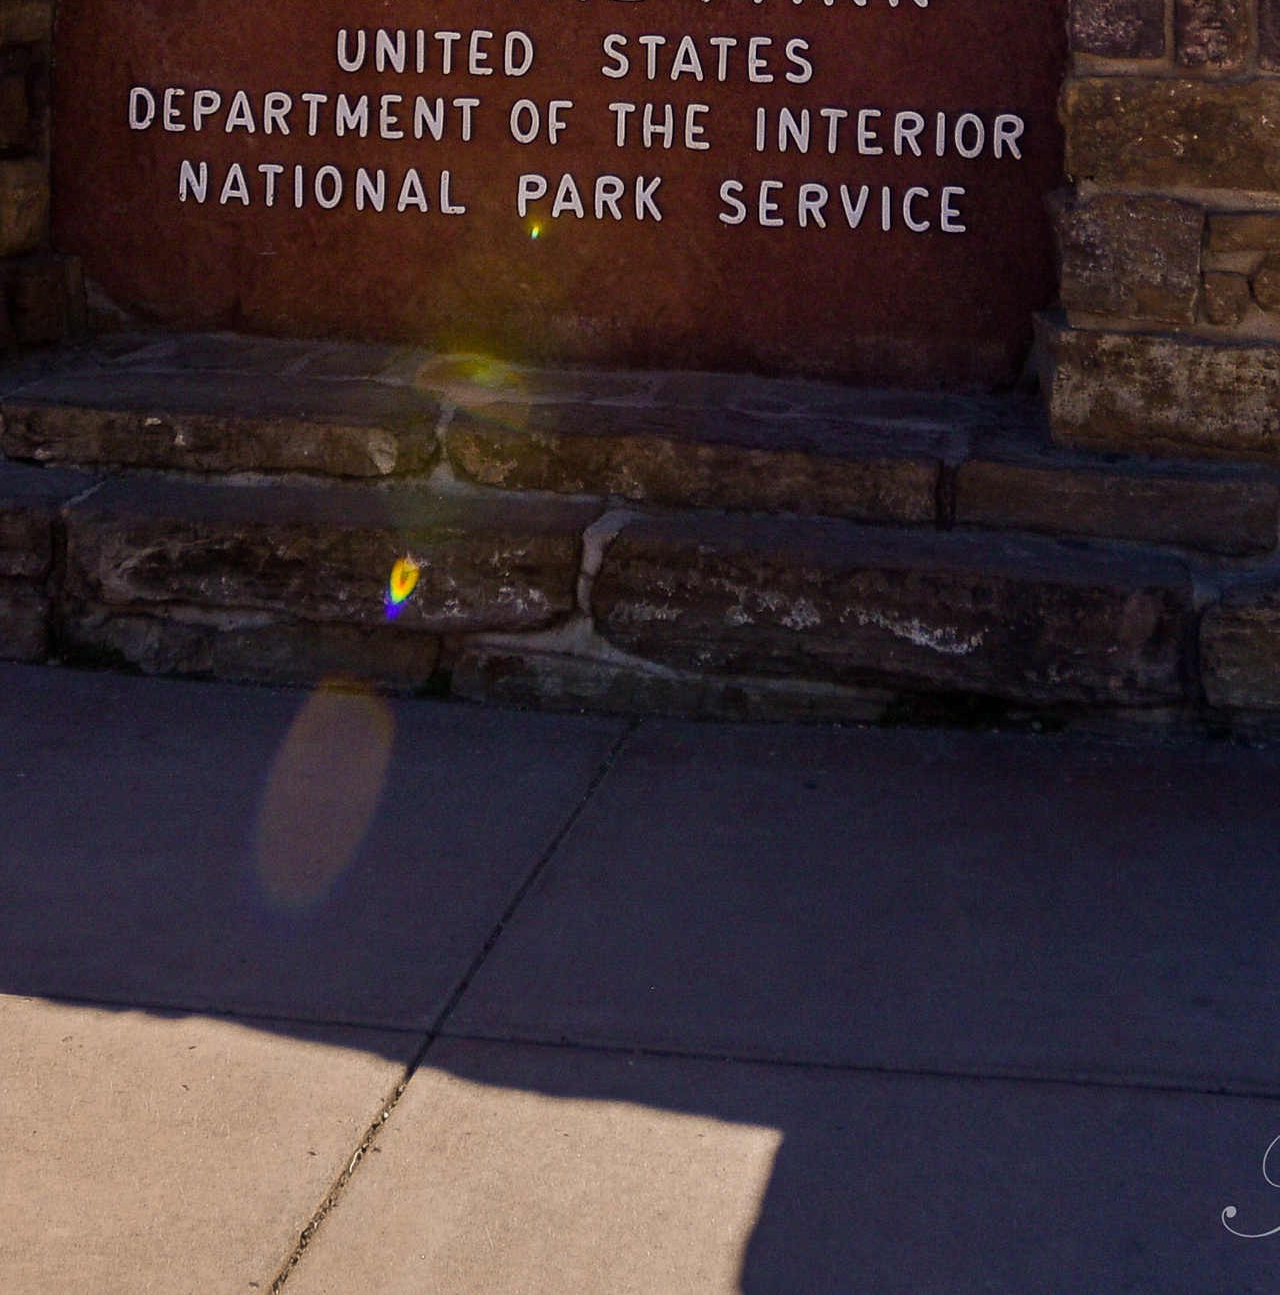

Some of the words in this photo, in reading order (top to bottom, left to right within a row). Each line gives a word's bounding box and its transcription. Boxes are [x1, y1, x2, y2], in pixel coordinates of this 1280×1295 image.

[336, 27, 535, 78] UNITED
[600, 33, 814, 85] STATES
[128, 85, 481, 143] DEPARTMENT
[509, 98, 574, 146] OF
[607, 101, 711, 151] THE
[755, 106, 1026, 161] INTERIOR
[178, 158, 467, 217] NATIONAL
[516, 172, 663, 223] PARK
[717, 178, 967, 234] SERVICE
